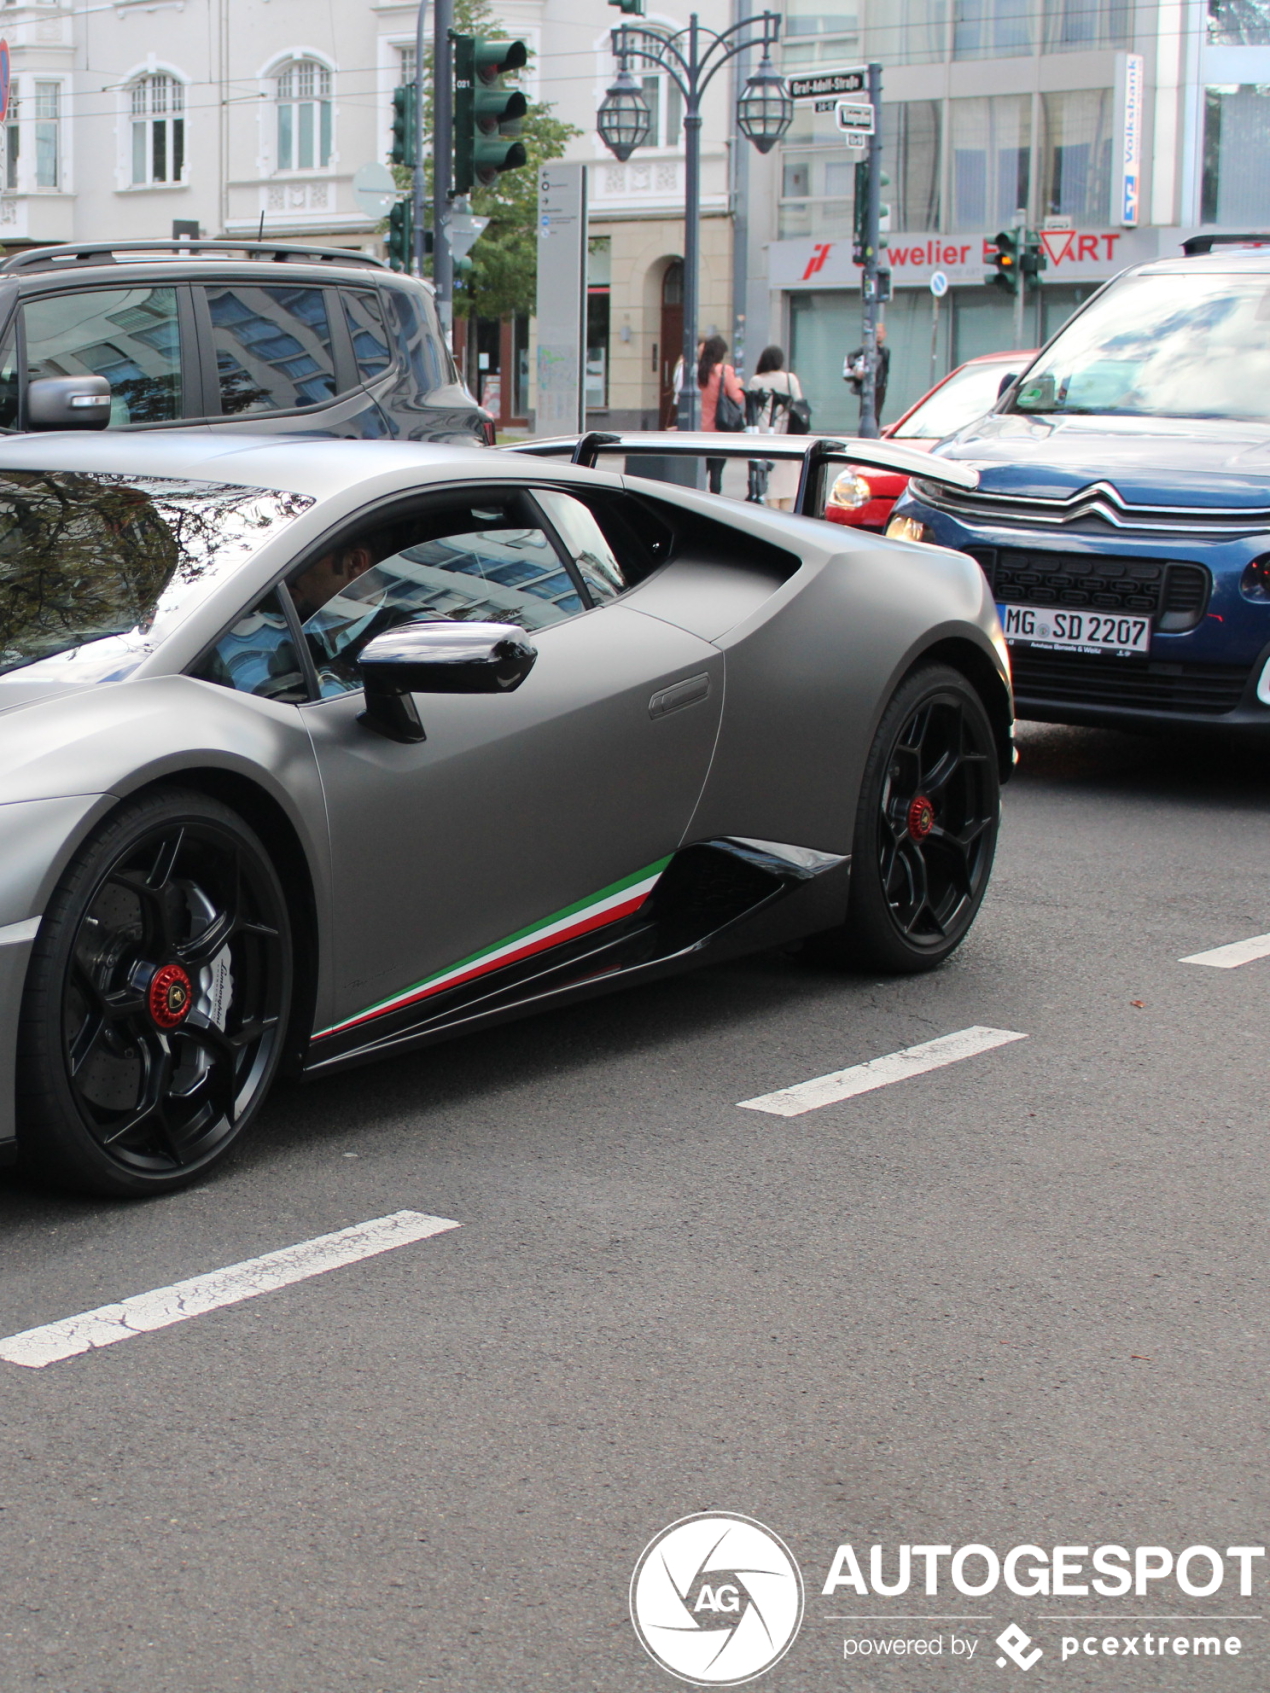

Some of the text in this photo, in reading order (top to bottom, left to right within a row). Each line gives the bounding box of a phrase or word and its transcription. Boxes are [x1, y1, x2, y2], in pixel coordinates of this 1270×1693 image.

[1125, 60, 1136, 163] Volksbank
[1006, 608, 1146, 646] MG SD 2207
[216, 958, 228, 1026] Lamborghini
